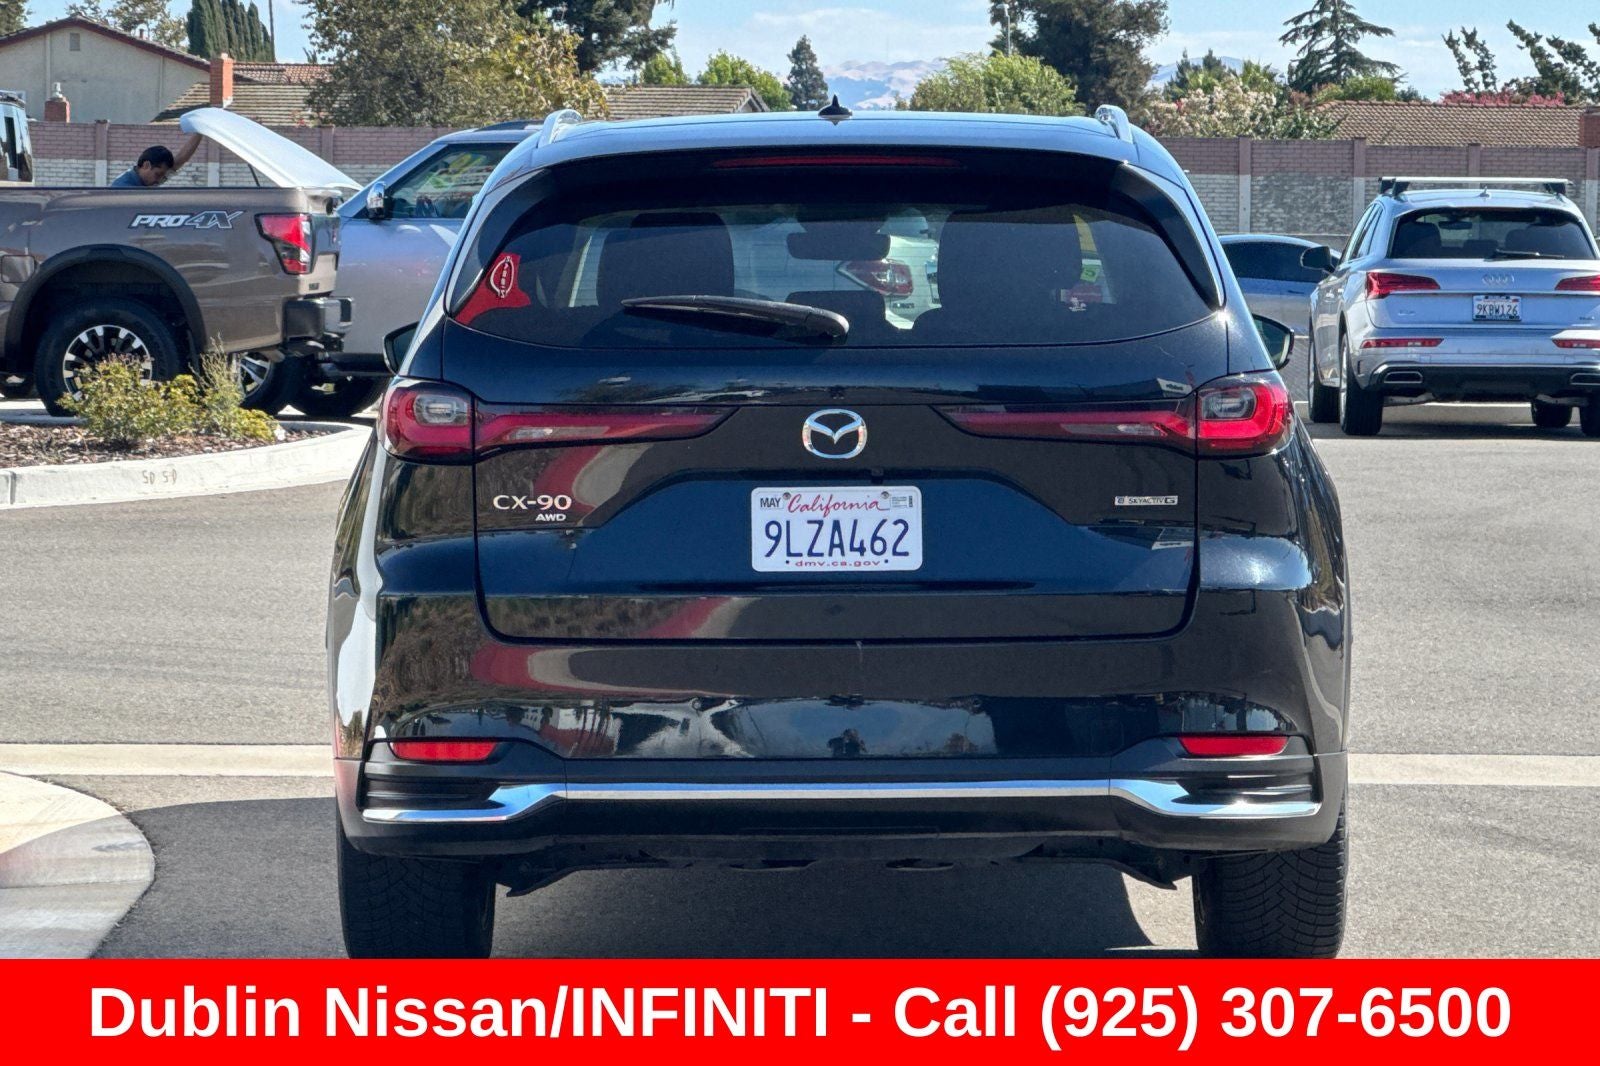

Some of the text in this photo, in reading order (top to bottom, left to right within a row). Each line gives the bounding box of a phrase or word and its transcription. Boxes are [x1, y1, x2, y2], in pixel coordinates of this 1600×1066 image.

[1476, 303, 1518, 316] 9KBW126
[493, 494, 572, 511] CX-90
[760, 497, 781, 508] MAY
[787, 493, 890, 518] California
[535, 513, 567, 522] AWD
[764, 518, 910, 558] 9LZA462
[795, 559, 881, 568] dmv.ca.gov
